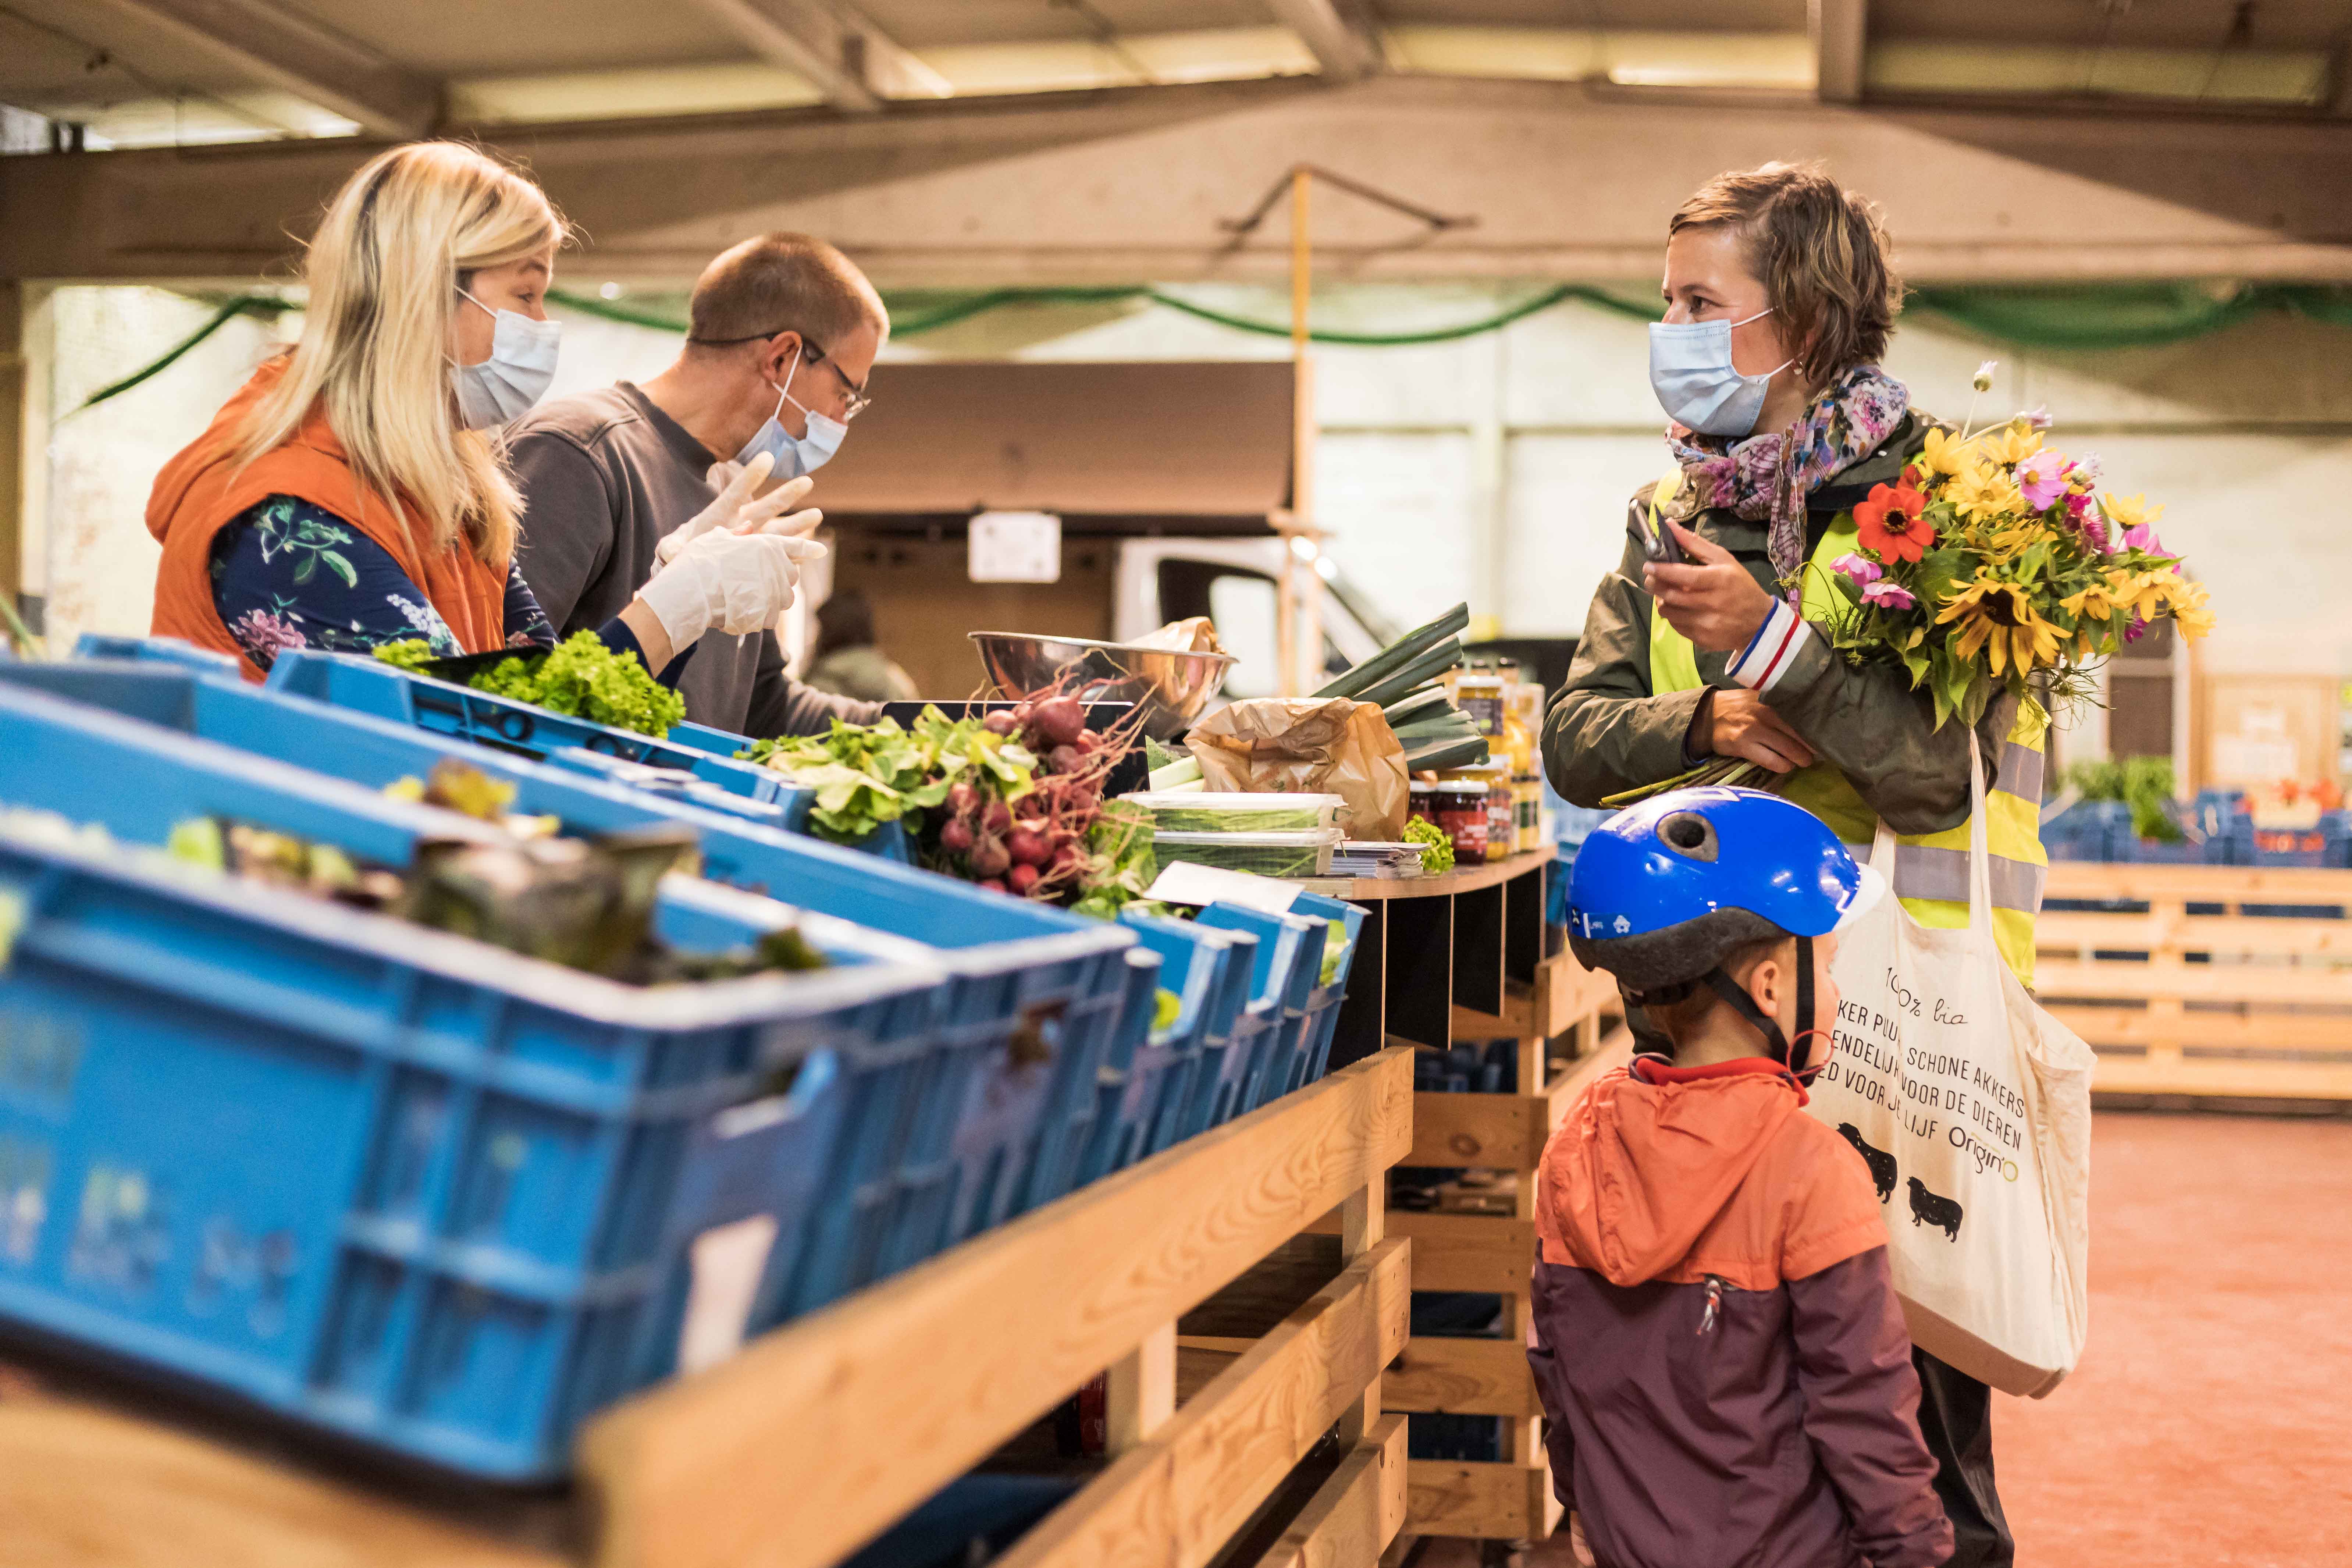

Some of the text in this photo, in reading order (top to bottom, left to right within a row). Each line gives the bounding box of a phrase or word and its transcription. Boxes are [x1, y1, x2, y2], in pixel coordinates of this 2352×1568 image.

[1886, 967, 1968, 1024] 100% bio
[1832, 1030, 2021, 1151] ENDELIJK VOOR DE DIEREN
[1837, 1000, 1868, 1026] KER
[1907, 1048, 1970, 1080] SCHONE
[1974, 1067, 2024, 1118] AKKERS
[1846, 1068, 1885, 1106] VOOR
[1904, 1109, 1938, 1139] LIJF
